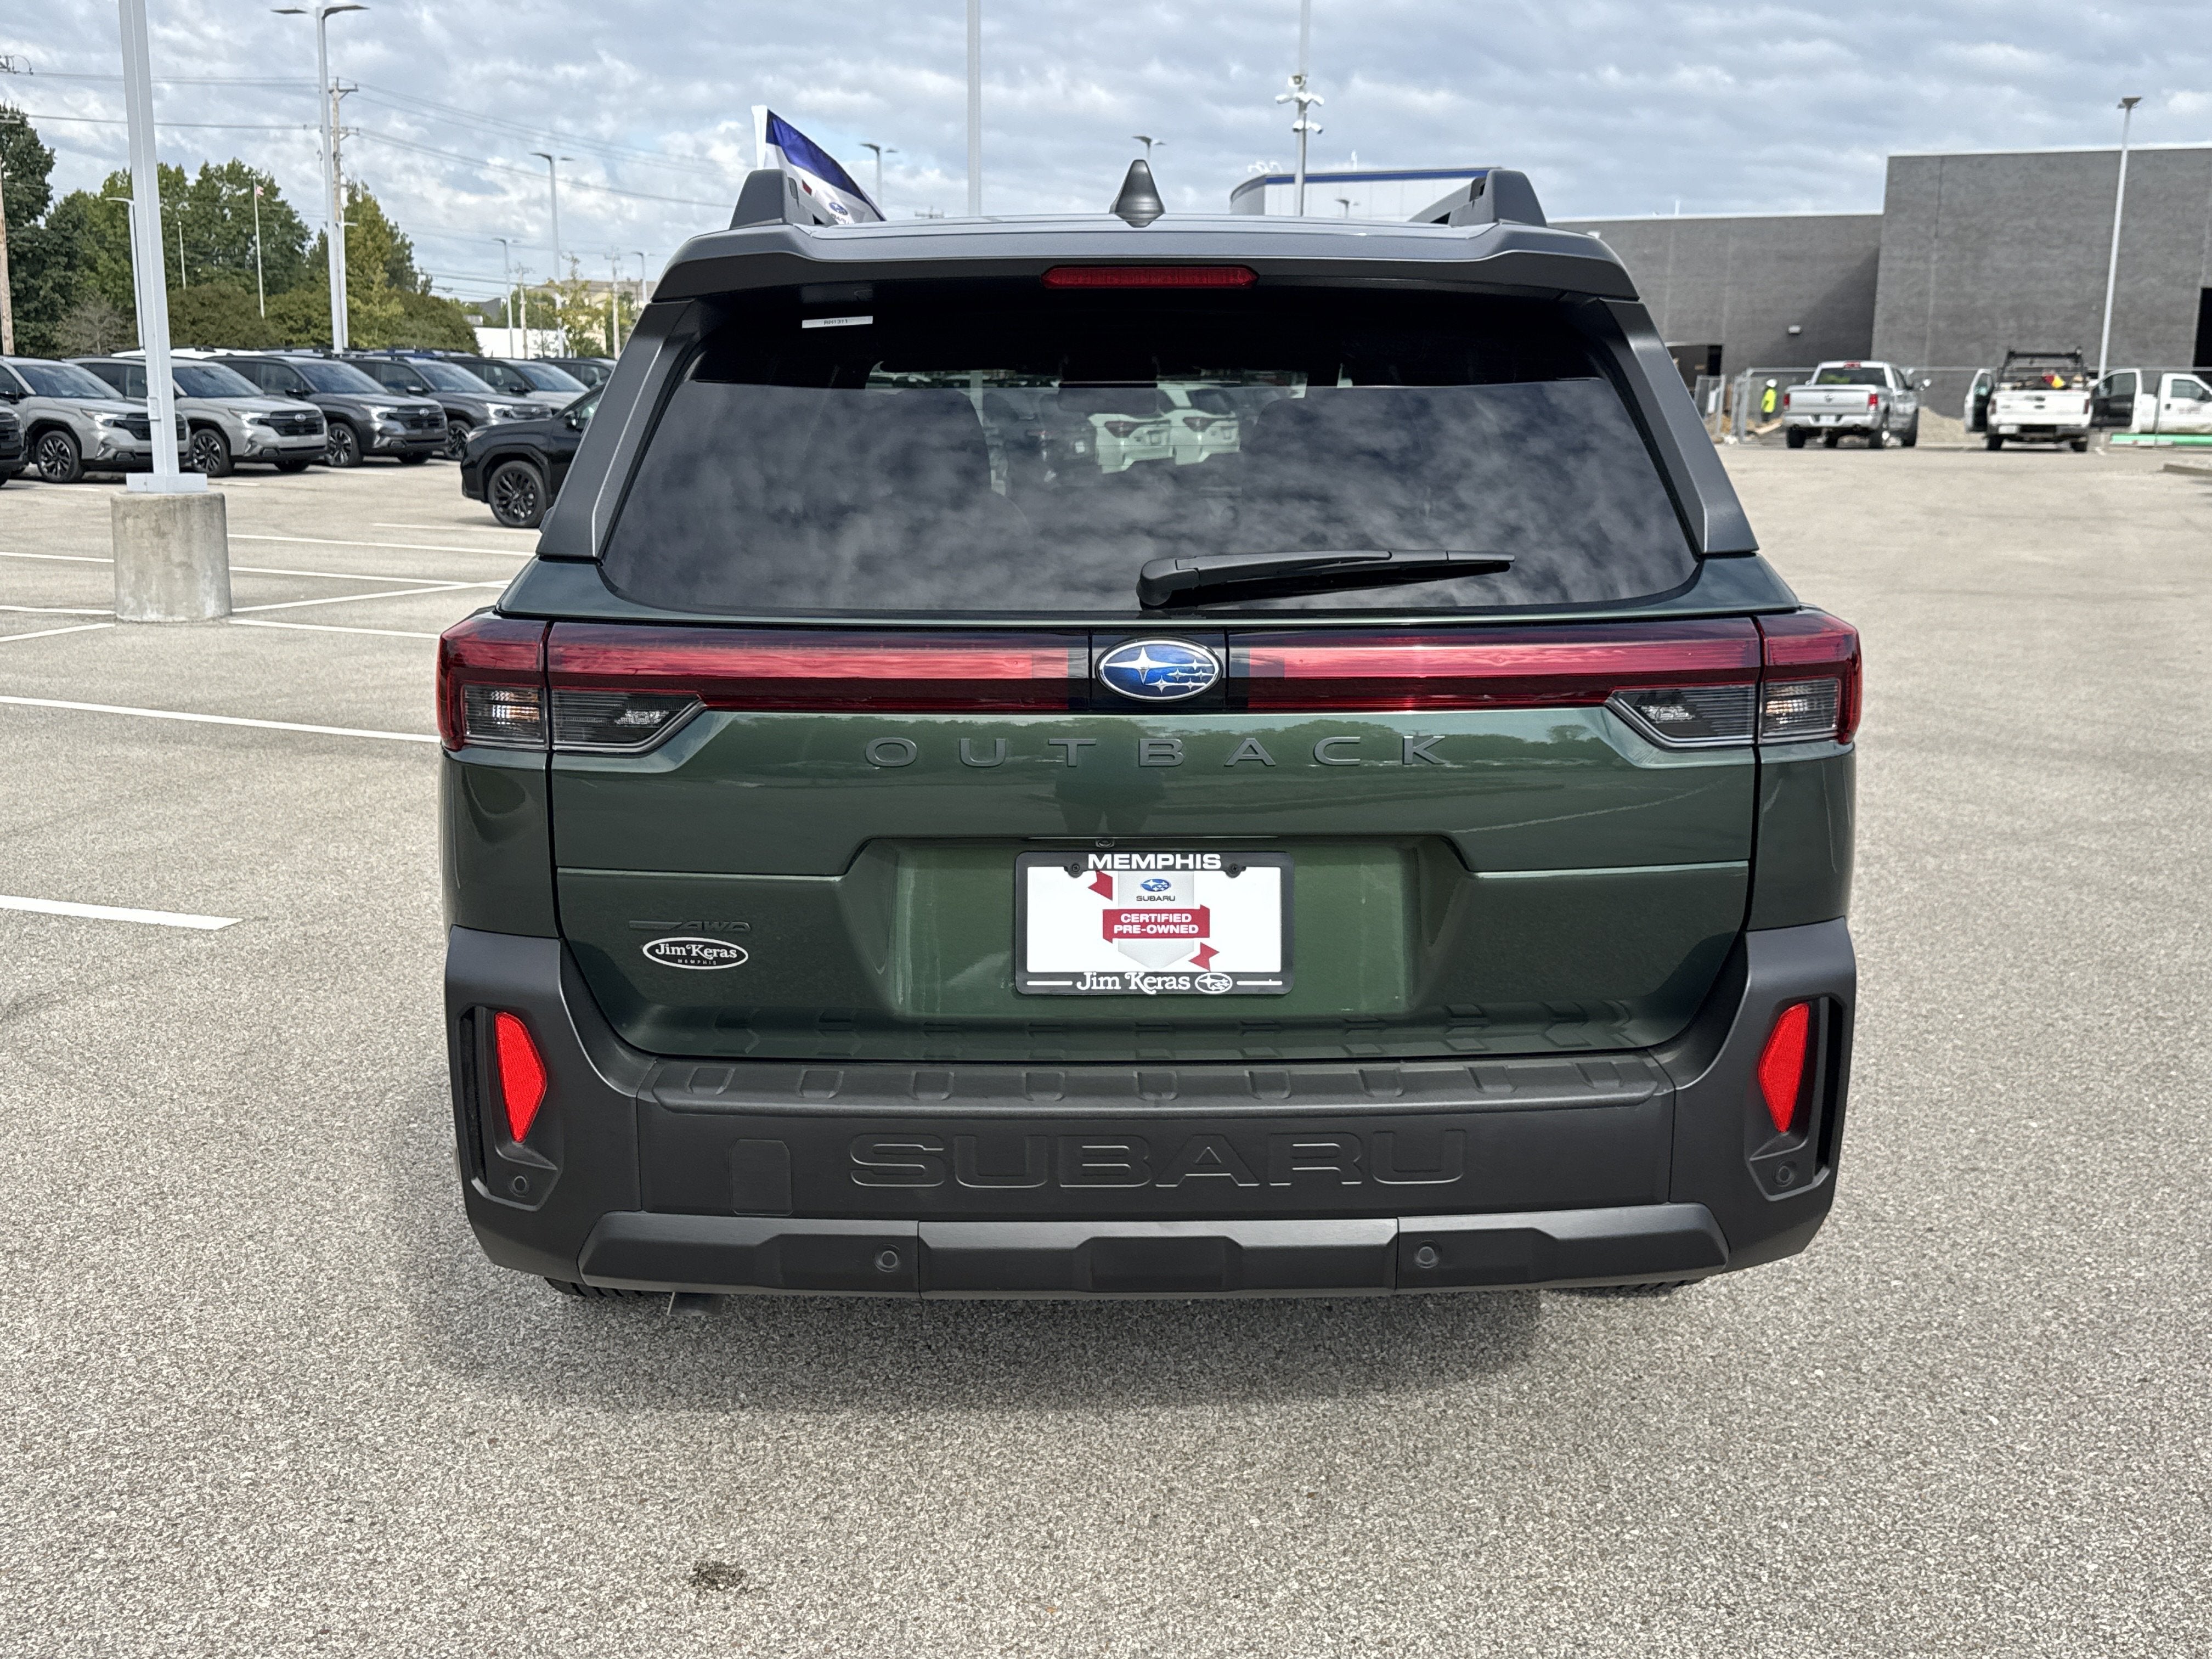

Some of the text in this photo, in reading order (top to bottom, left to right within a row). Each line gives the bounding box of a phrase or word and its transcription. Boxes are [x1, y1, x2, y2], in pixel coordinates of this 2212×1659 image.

[865, 735, 1446, 767] OUTBACK
[1087, 854, 1222, 870] MEMPHIS
[1120, 913, 1192, 923] CERTIFIED
[677, 921, 752, 932] AWD
[1114, 924, 1199, 934] PRE-OWNED
[655, 943, 737, 960] Jim Keras
[1076, 972, 1190, 995] Jim Keras
[850, 1129, 1467, 1188] SUBARU
